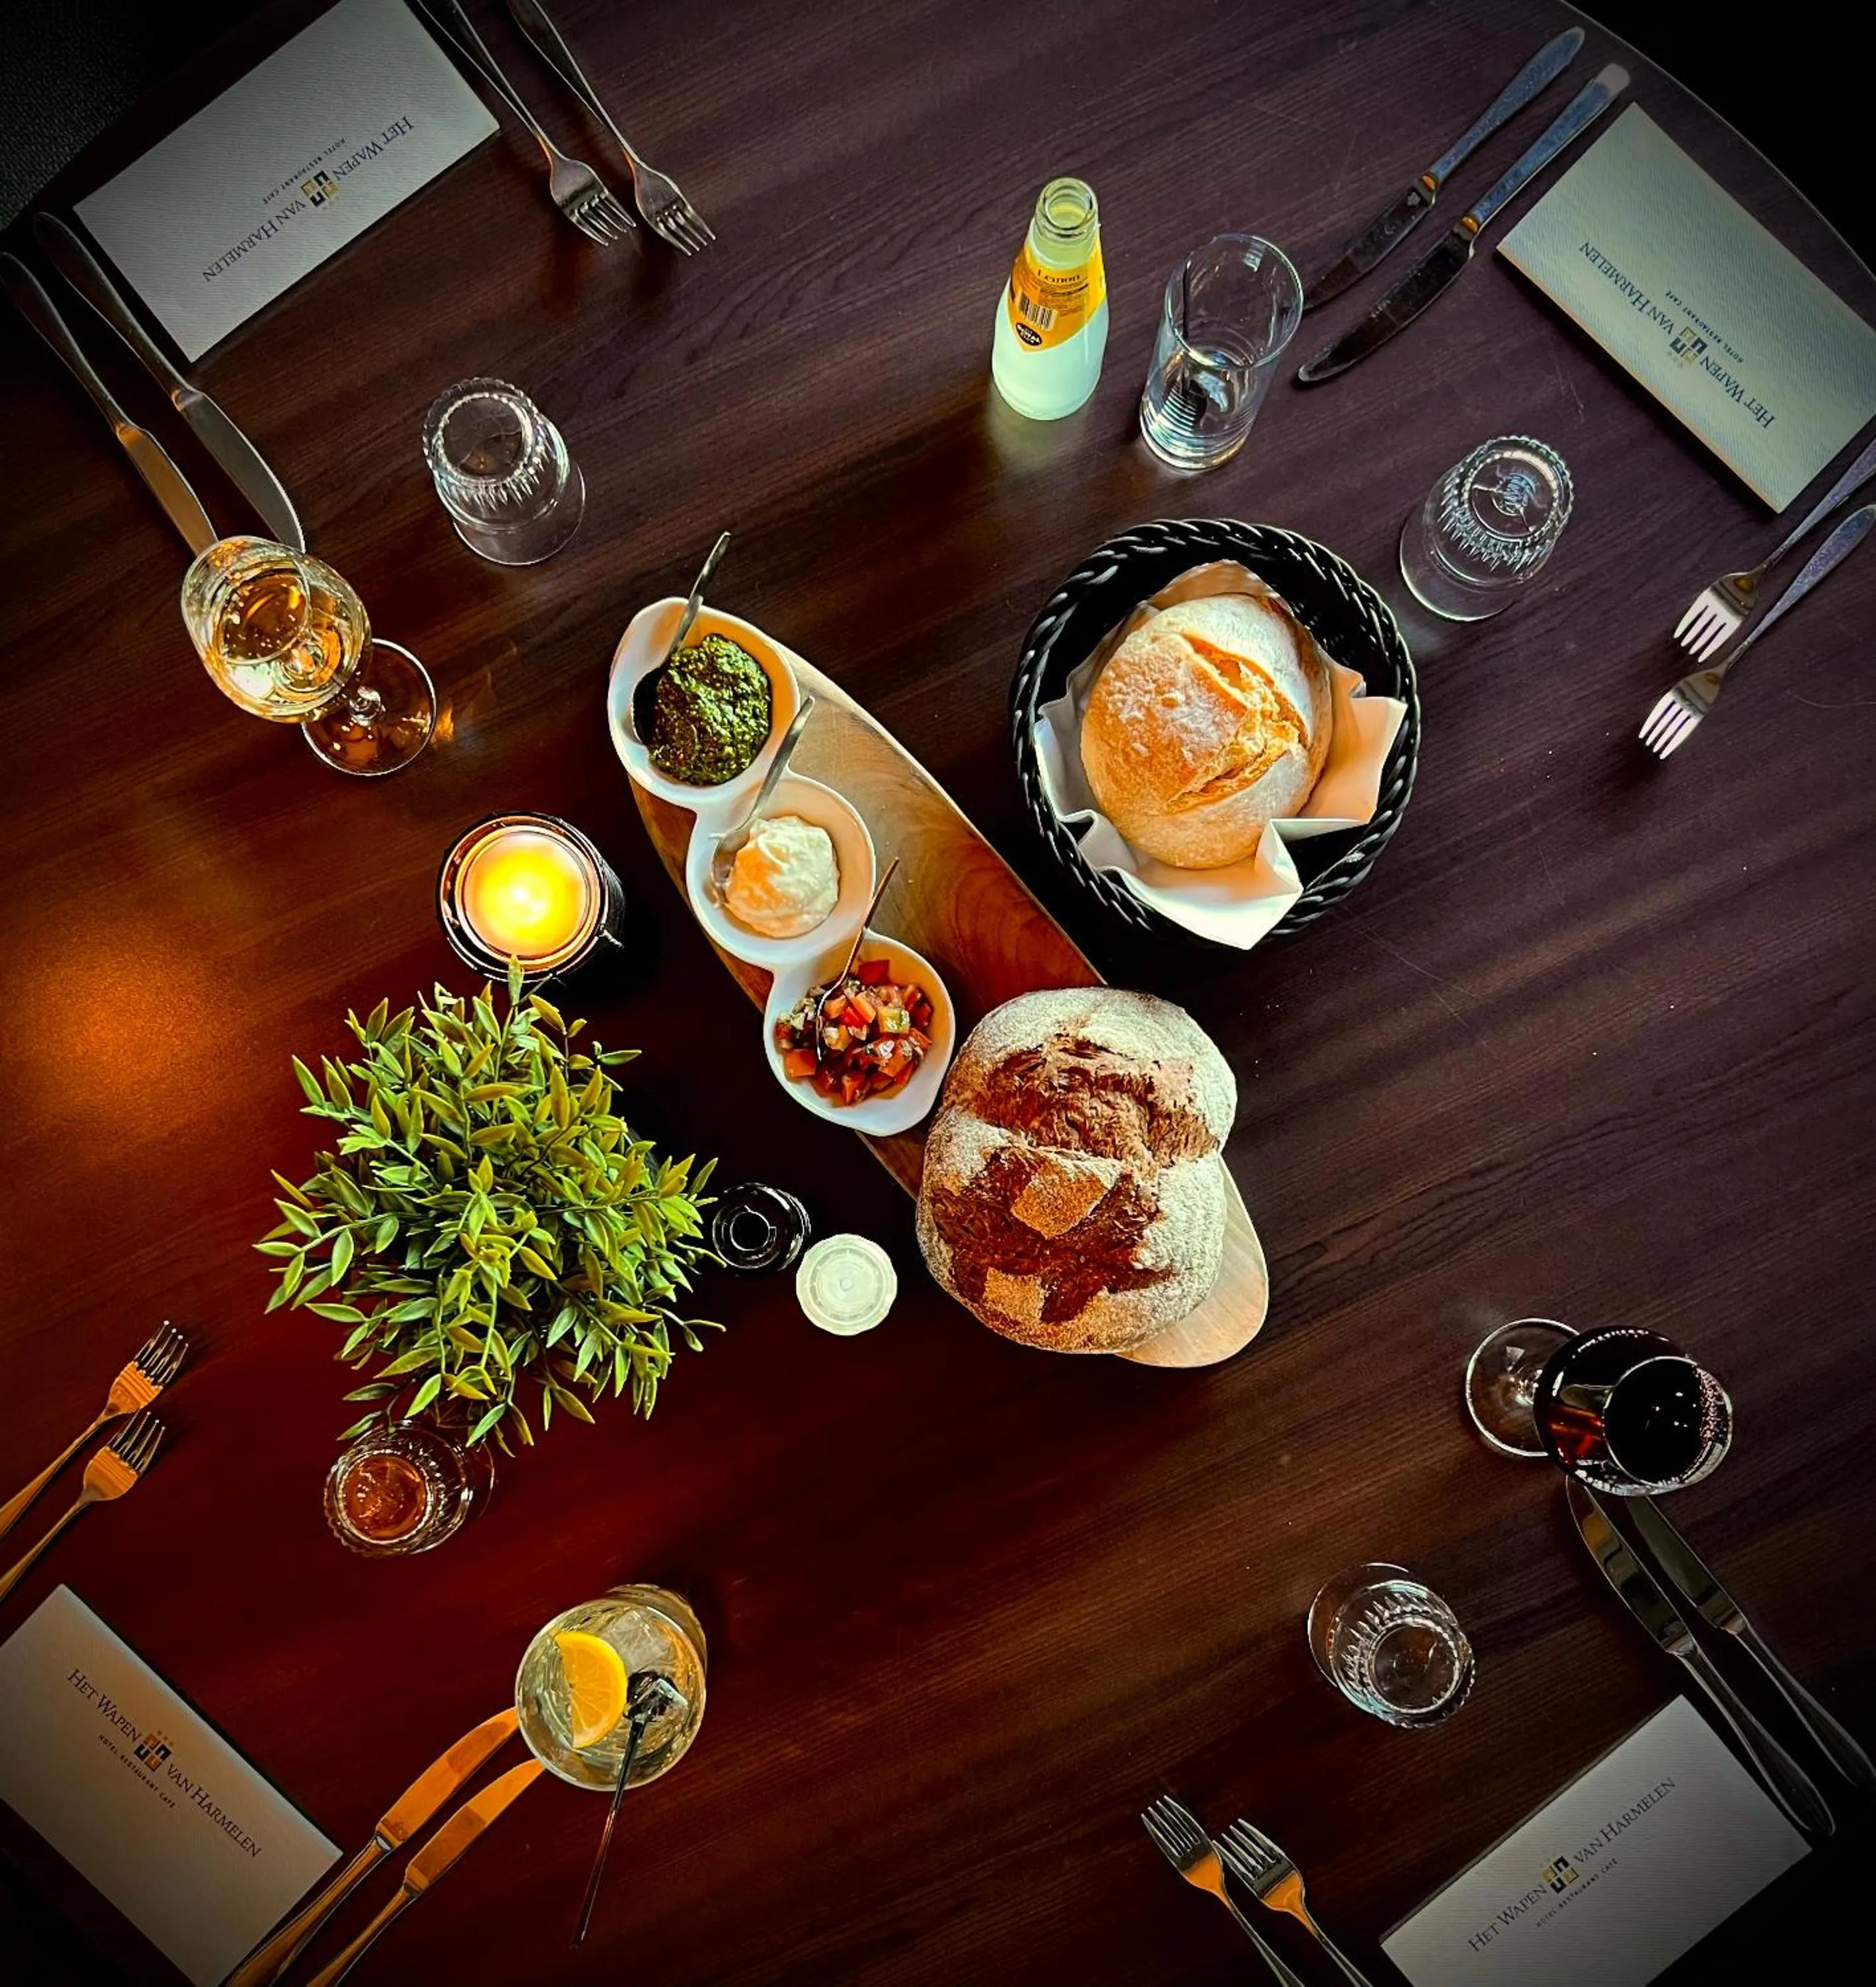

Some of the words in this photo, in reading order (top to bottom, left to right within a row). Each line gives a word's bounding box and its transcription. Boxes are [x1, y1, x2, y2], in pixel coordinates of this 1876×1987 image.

[326, 138, 345, 157] HOTEL
[1723, 343, 1744, 364] HOTEL
[98, 1735, 119, 1754] HOTEL
[1536, 1909, 1557, 1928] HOTEL
